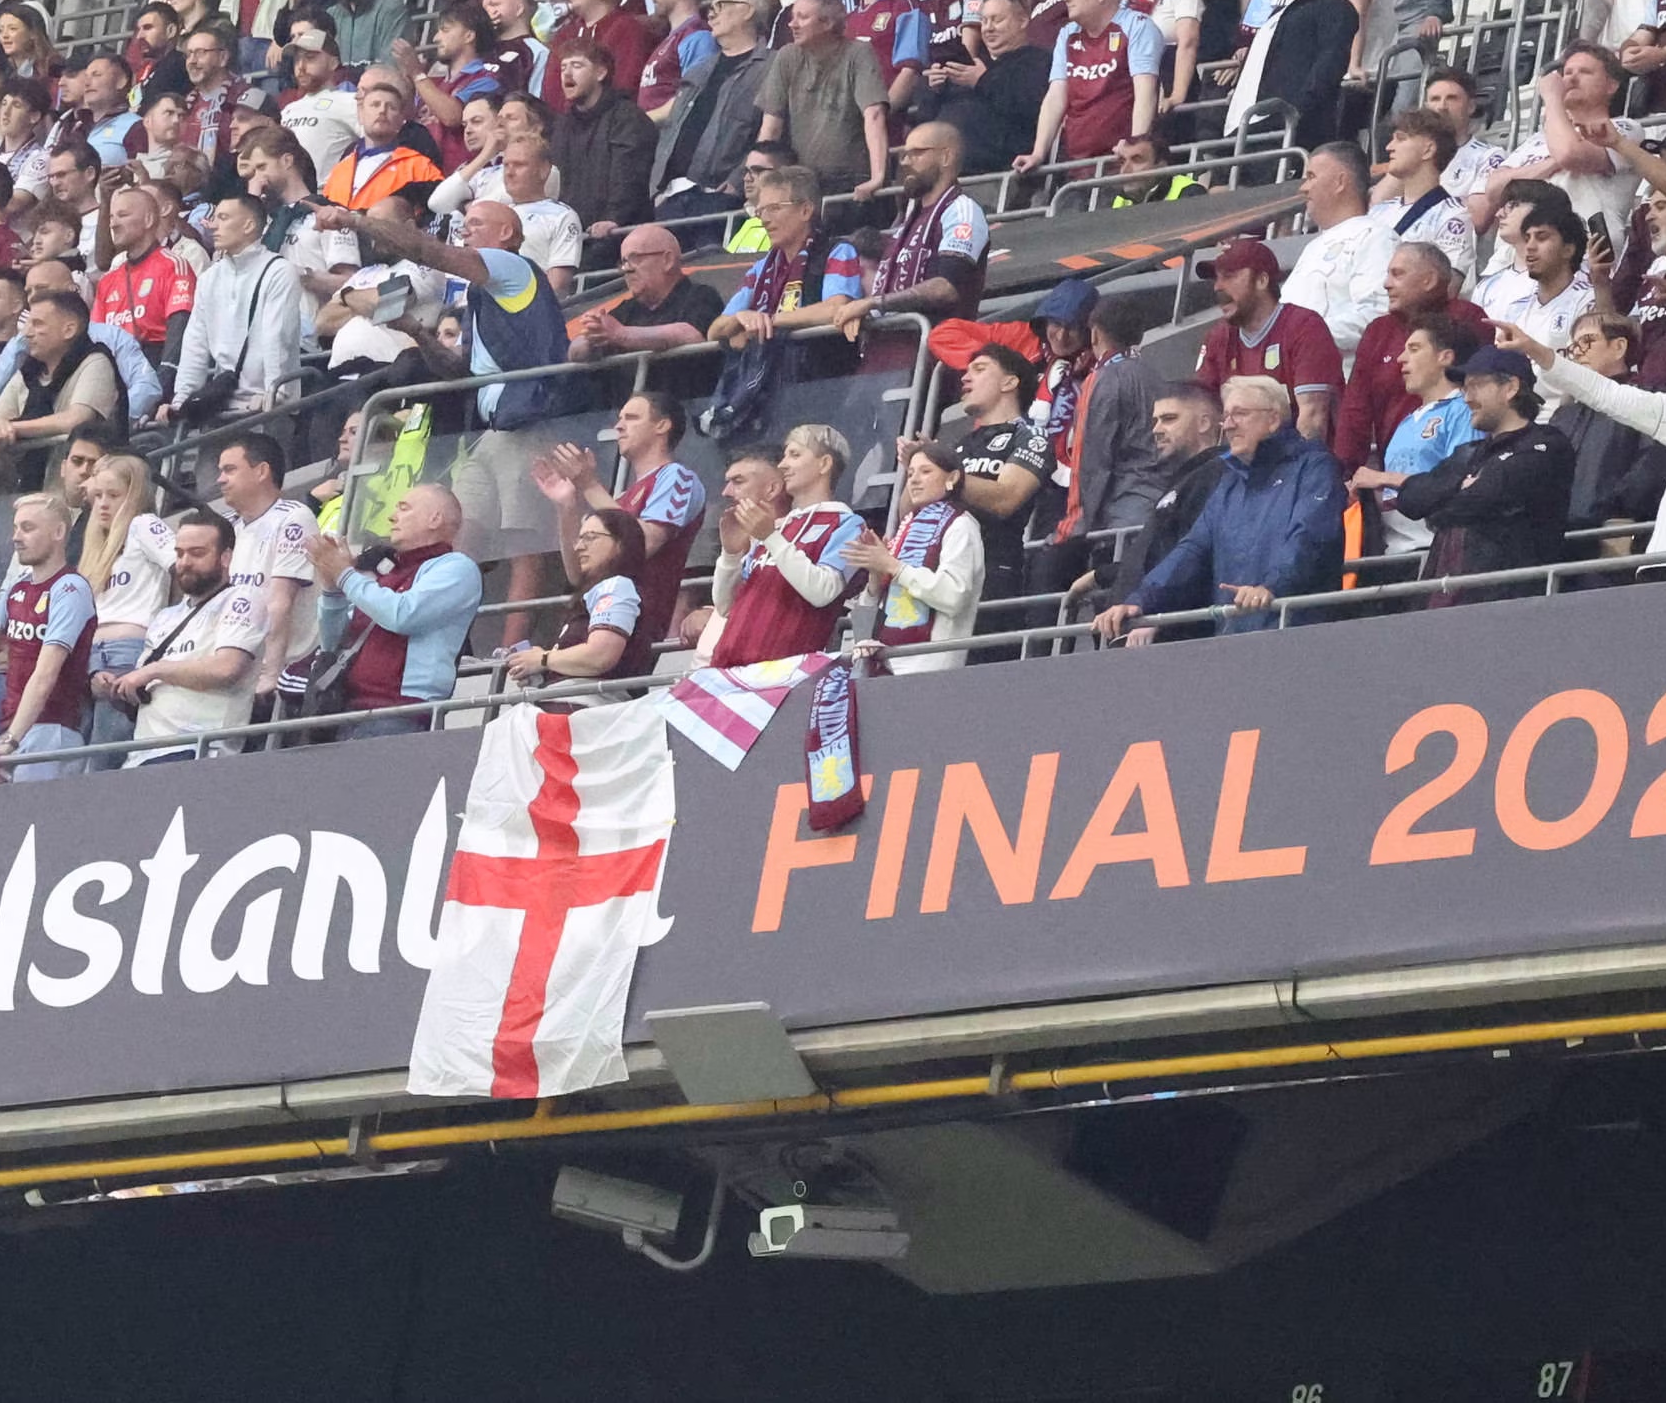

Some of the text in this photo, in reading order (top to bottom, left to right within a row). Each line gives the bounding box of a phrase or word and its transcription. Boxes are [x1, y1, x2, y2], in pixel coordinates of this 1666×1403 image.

[751, 729, 1307, 933] FINAL
[1292, 1383, 1324, 1403] 86
[1537, 1361, 1574, 1398] 87
